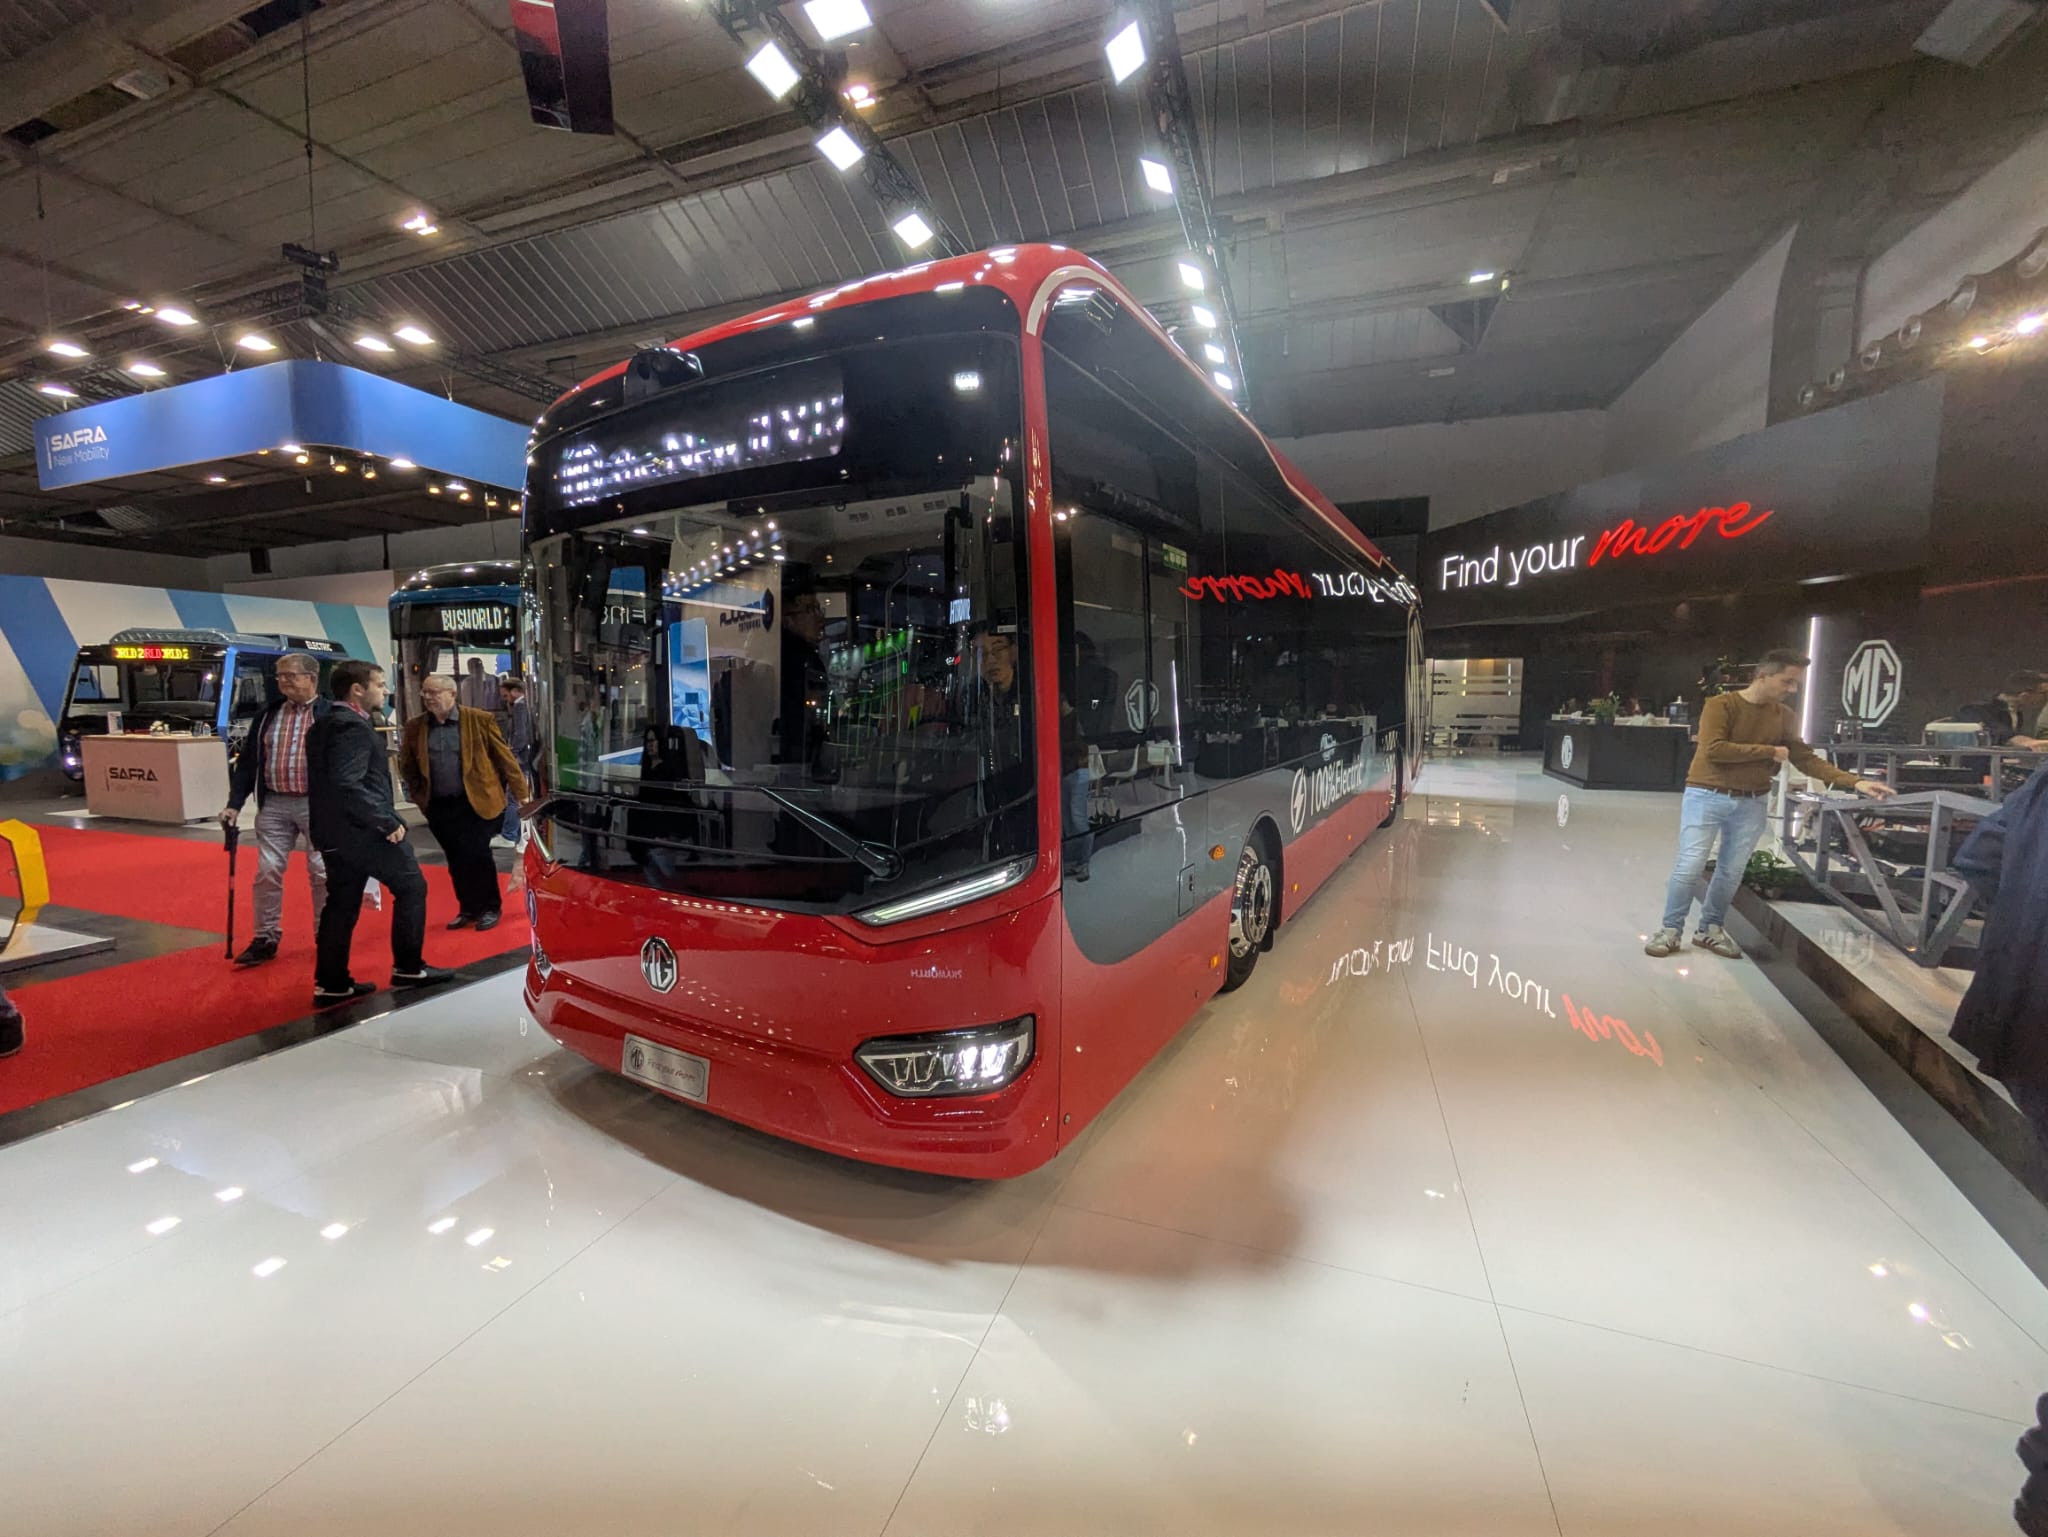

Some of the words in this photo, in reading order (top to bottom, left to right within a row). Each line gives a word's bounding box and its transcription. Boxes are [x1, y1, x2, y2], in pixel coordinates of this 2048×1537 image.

[50, 425, 108, 452] SAFRA
[1442, 545, 1499, 590] Find
[1505, 535, 1585, 587] your
[1588, 501, 1774, 567] more
[441, 606, 502, 632] BUSWORLD
[1846, 646, 1898, 722] MG
[109, 766, 158, 782] SAFRA
[642, 941, 675, 990] MG
